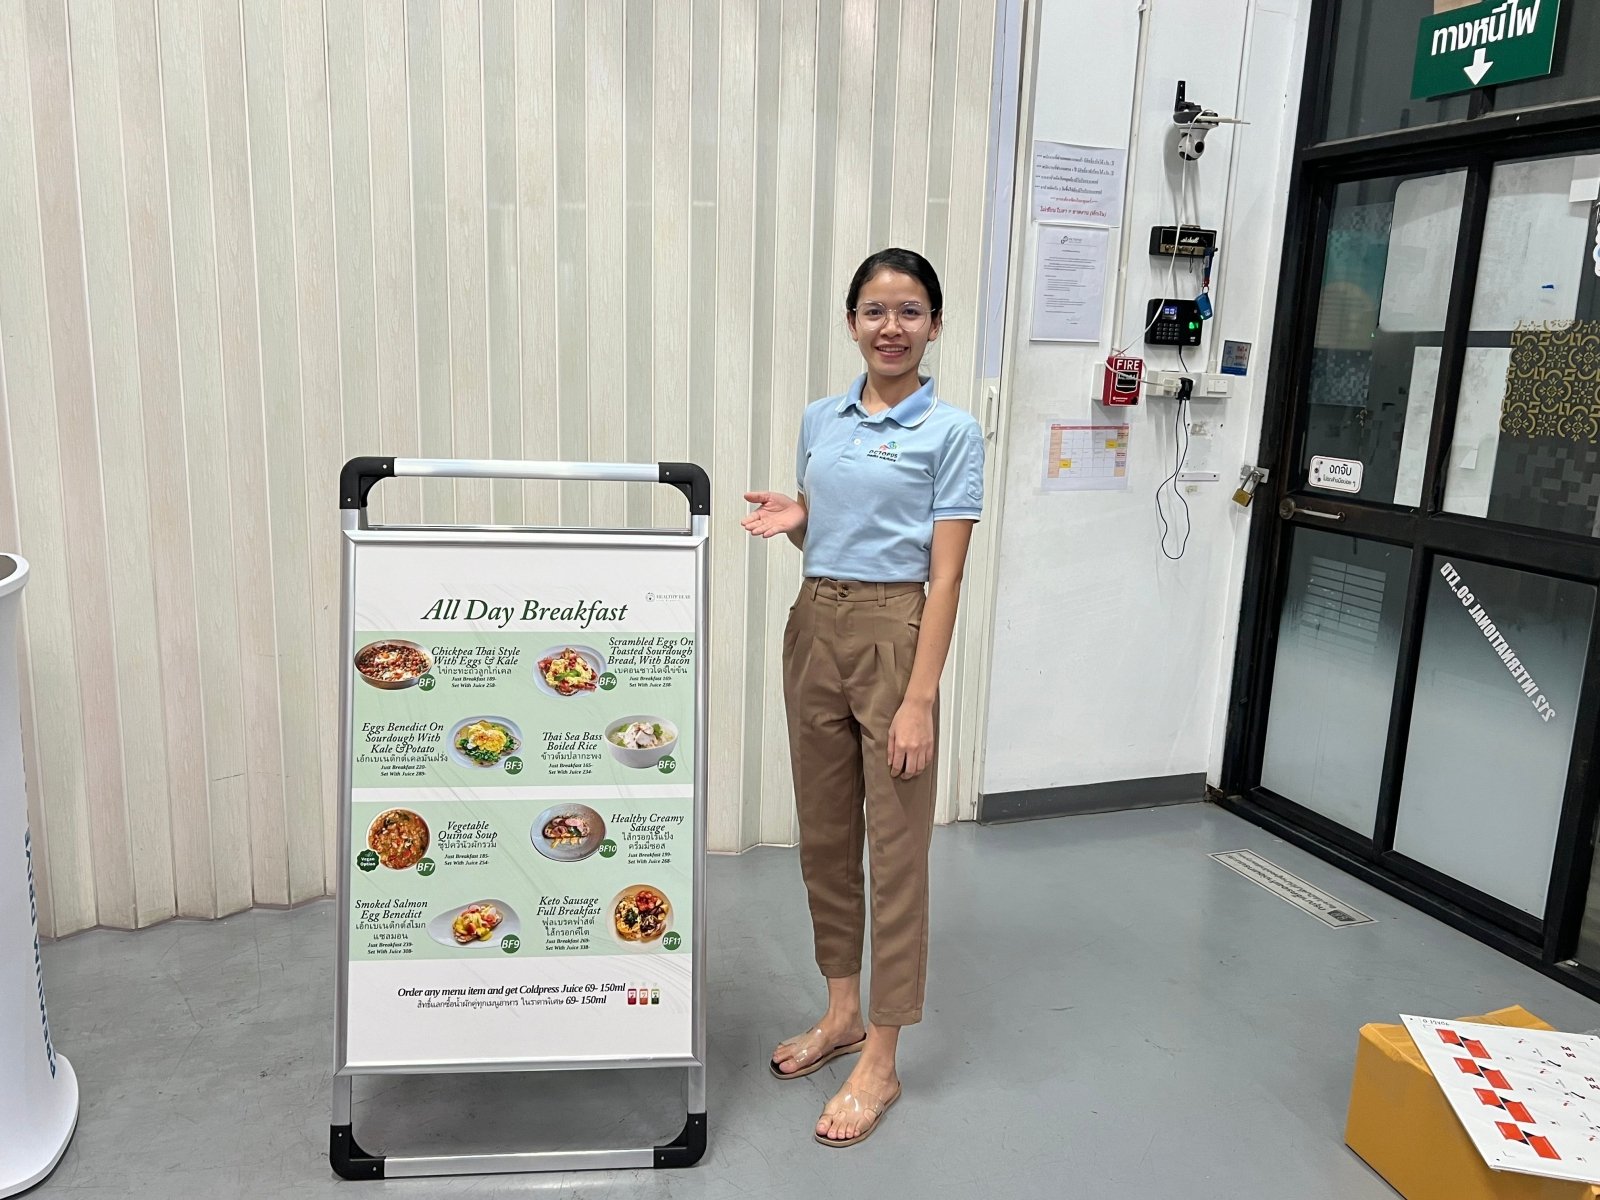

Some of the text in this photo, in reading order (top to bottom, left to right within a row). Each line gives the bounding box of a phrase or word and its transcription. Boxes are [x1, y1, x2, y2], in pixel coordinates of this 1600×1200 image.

[1430, 0, 1540, 56] ทางหนีไฟ
[1117, 360, 1140, 370] FIRE
[1329, 464, 1352, 476] งดจับ
[420, 599, 629, 629] All Day Breakfast
[609, 637, 694, 649] Scrambled Eggs On
[432, 646, 521, 658] Chickpea Thai Style
[610, 647, 693, 658] Toasted Sourdough
[434, 656, 519, 668] With Eggs & Kale
[608, 656, 690, 665] Bread, With Bacon
[417, 678, 435, 687] BF1
[599, 677, 616, 685] BF4
[362, 722, 444, 734] Eggs Benedict On
[365, 733, 441, 745] Sourdough With
[542, 732, 602, 741] Thai Sea Bass
[371, 744, 393, 753] Kale
[547, 742, 598, 750] Boiled Rice
[504, 759, 522, 770] BF3
[658, 760, 676, 768] BF6
[611, 813, 684, 825] Healthy Creamy
[447, 821, 489, 833] Vegetable
[630, 823, 665, 834] Sausage
[438, 830, 498, 842] Quinoa Soup
[417, 862, 435, 871] BF7
[355, 899, 428, 909] Smoked Salmon
[540, 896, 599, 908] Keto Sausage
[361, 910, 422, 922] Egg Benedict
[537, 907, 602, 918] Full Breakfast
[502, 940, 520, 949] BF9
[663, 937, 681, 945] BF11
[397, 983, 626, 998] Order any menu item and get Coldpress Juice 69- 150ml
[565, 996, 579, 1005] 69-
[581, 995, 607, 1004] 150ml
